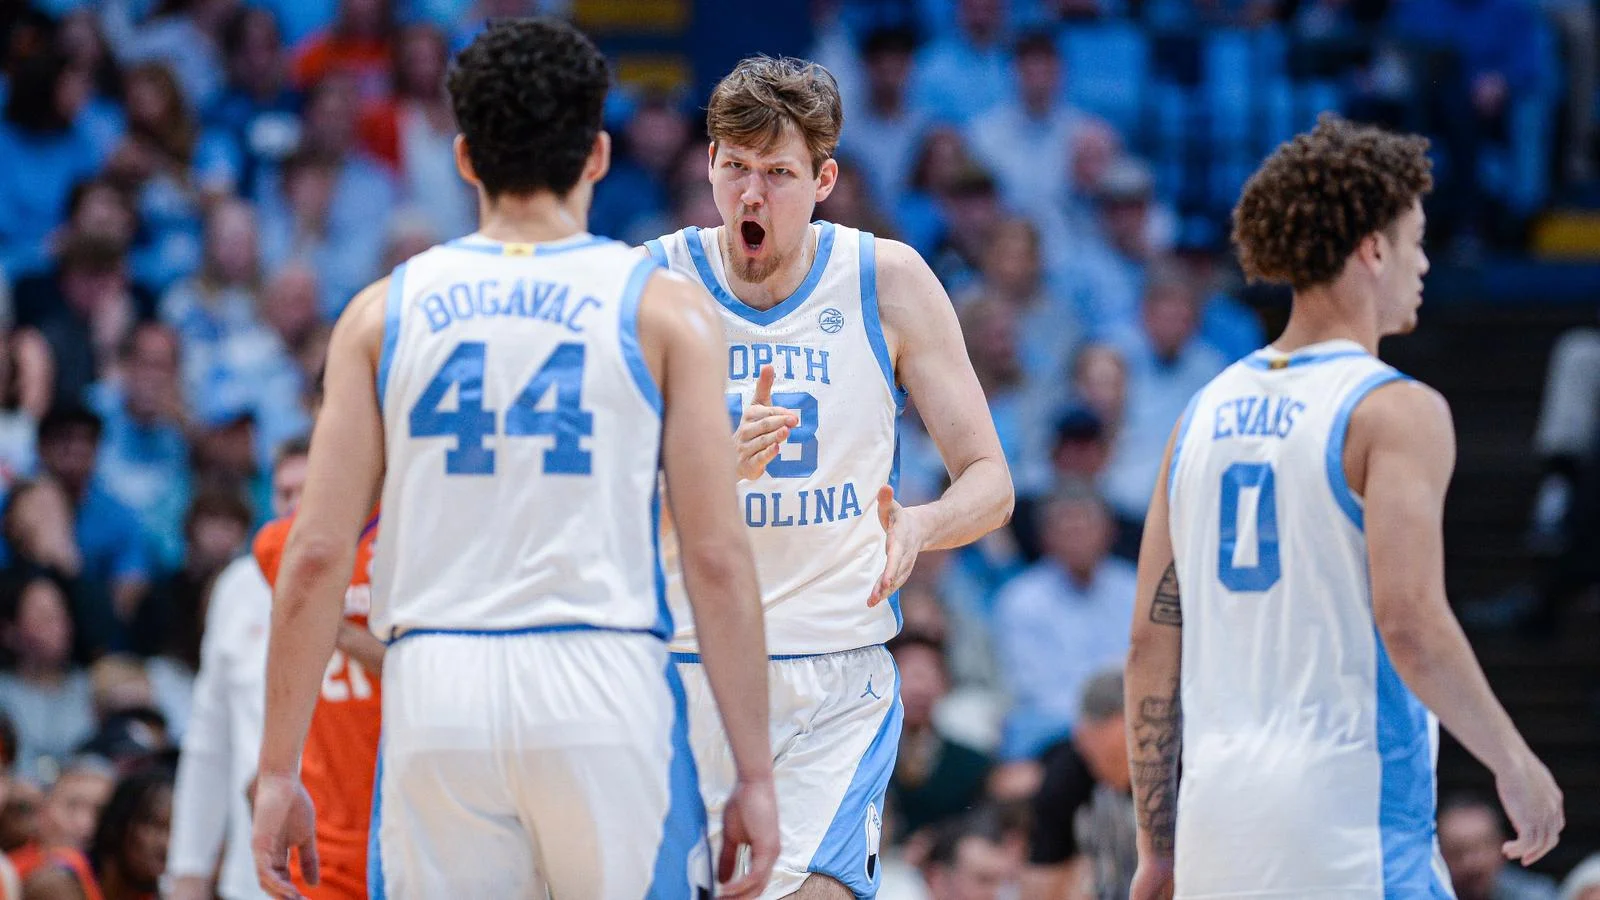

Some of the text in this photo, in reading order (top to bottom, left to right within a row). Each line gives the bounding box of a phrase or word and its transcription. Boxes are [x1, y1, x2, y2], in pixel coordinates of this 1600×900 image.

[419, 276, 602, 333] BOGAVAC
[728, 343, 831, 385] ORTH
[409, 340, 594, 476] 44
[1213, 396, 1307, 440] EVANS
[745, 482, 863, 528] OLINA
[1218, 462, 1281, 592] 0
